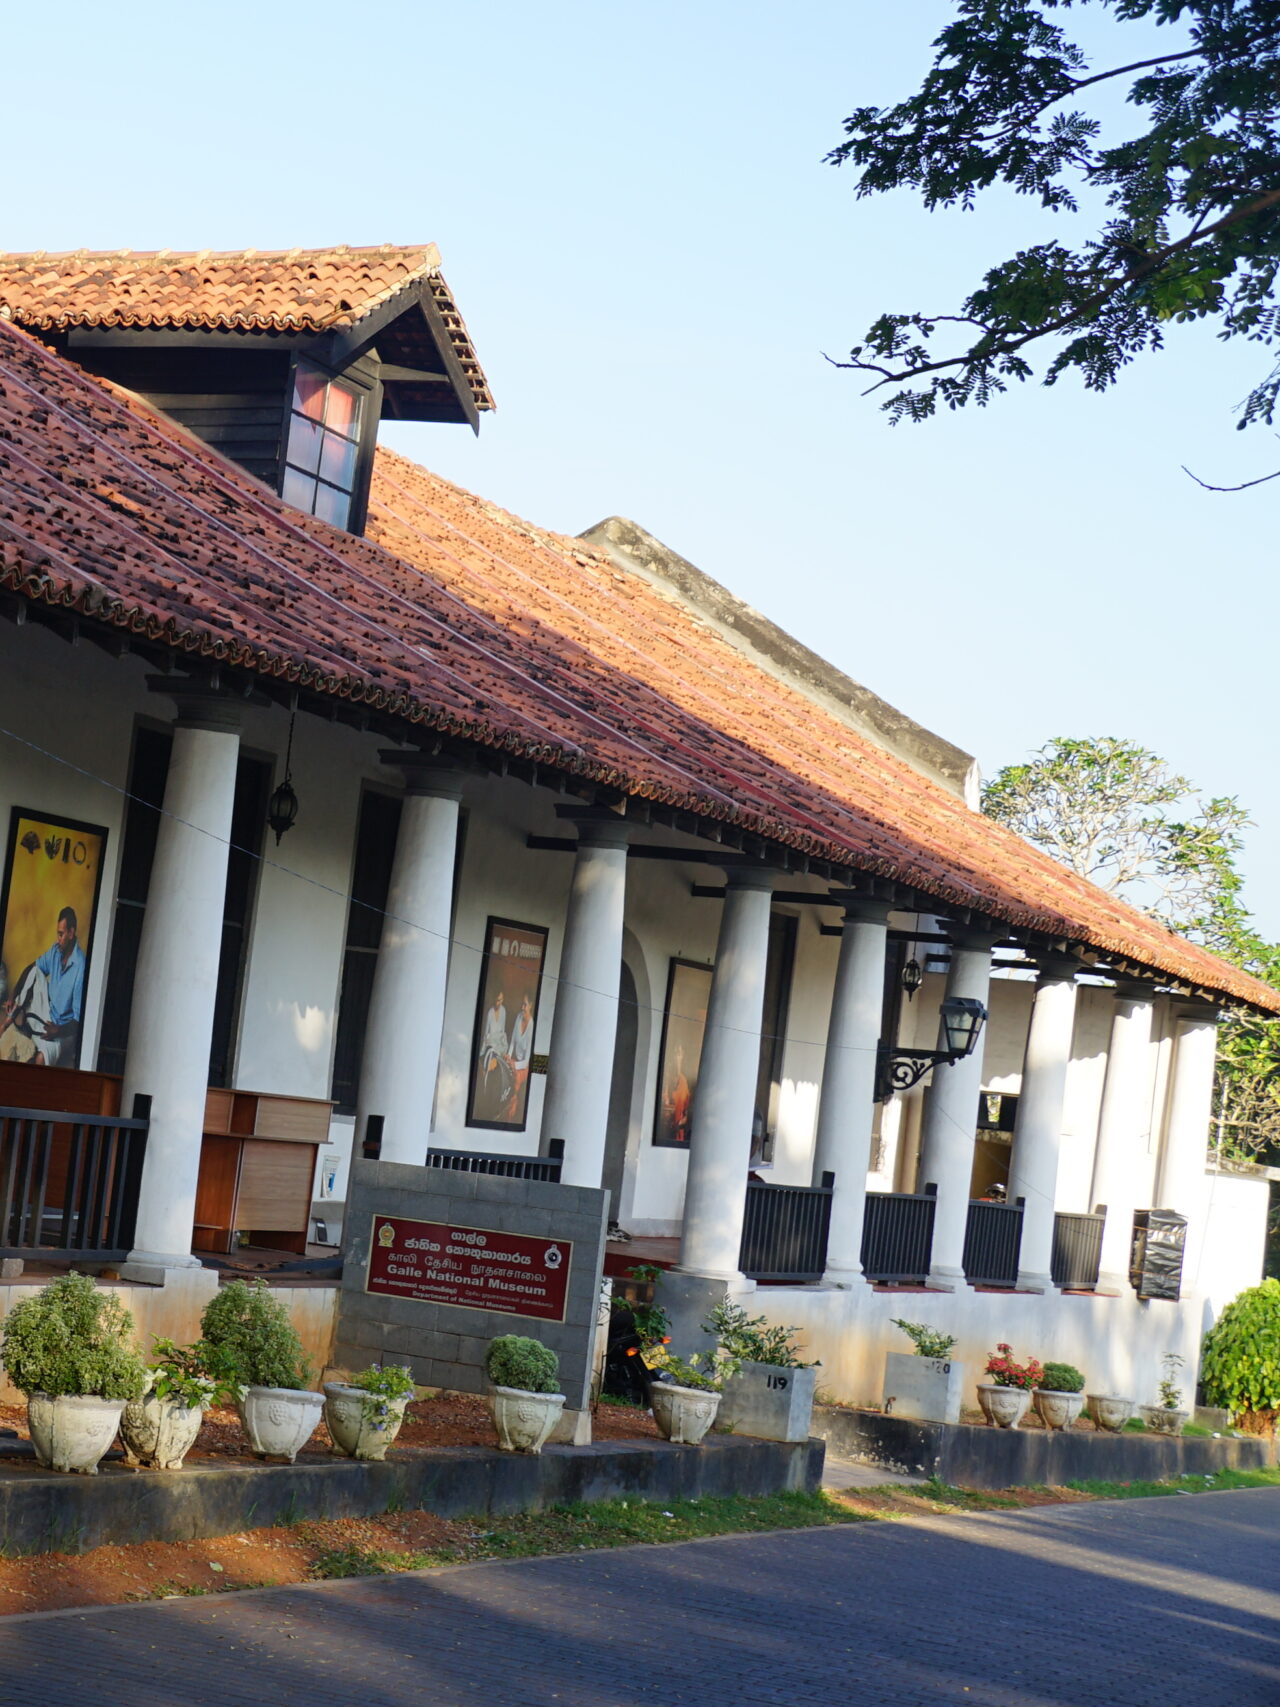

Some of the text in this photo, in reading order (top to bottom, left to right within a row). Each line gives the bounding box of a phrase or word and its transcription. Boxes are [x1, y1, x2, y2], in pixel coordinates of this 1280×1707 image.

[451, 1231, 487, 1246] ගාල්ල
[388, 1252, 546, 1283] காலி தேசிய நூதனசாலை
[387, 1264, 422, 1278] Galle
[426, 1269, 483, 1287] National
[488, 1278, 546, 1296] Museum
[412, 1290, 449, 1301] Department
[458, 1297, 485, 1306] National
[766, 1374, 788, 1390] 119
